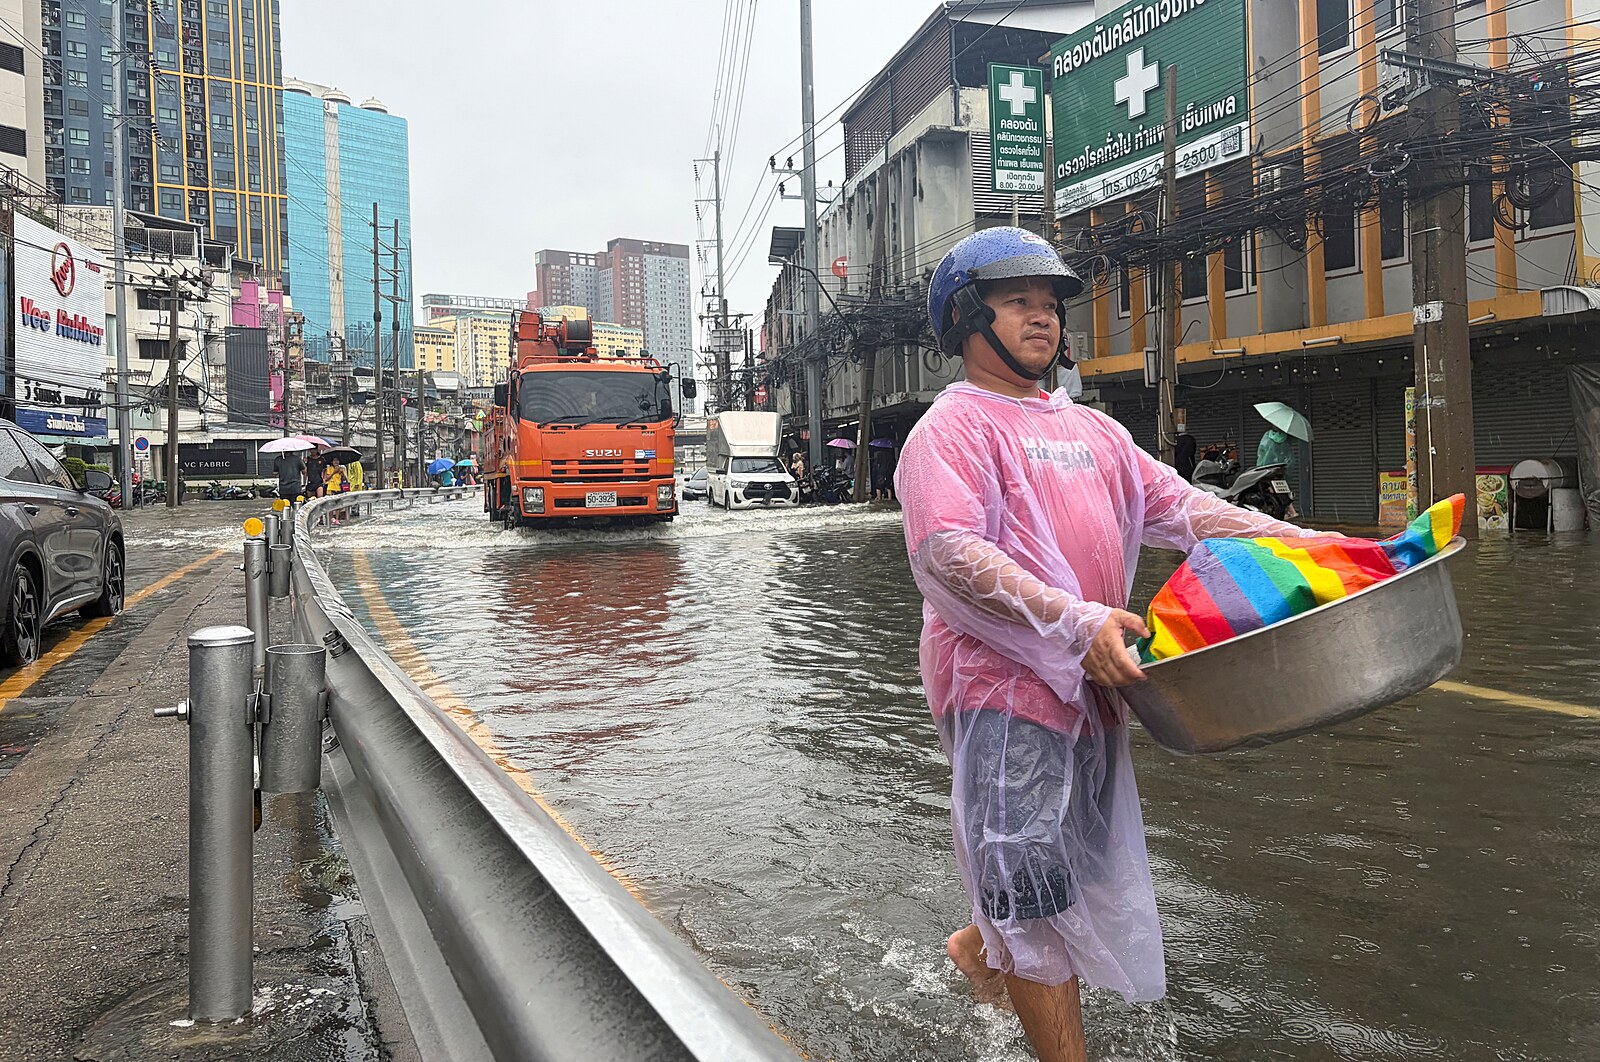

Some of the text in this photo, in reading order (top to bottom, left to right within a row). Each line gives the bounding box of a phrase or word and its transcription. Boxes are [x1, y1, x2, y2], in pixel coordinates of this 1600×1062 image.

[1000, 118, 1037, 131] คลองตัน
[21, 296, 51, 332] Vee
